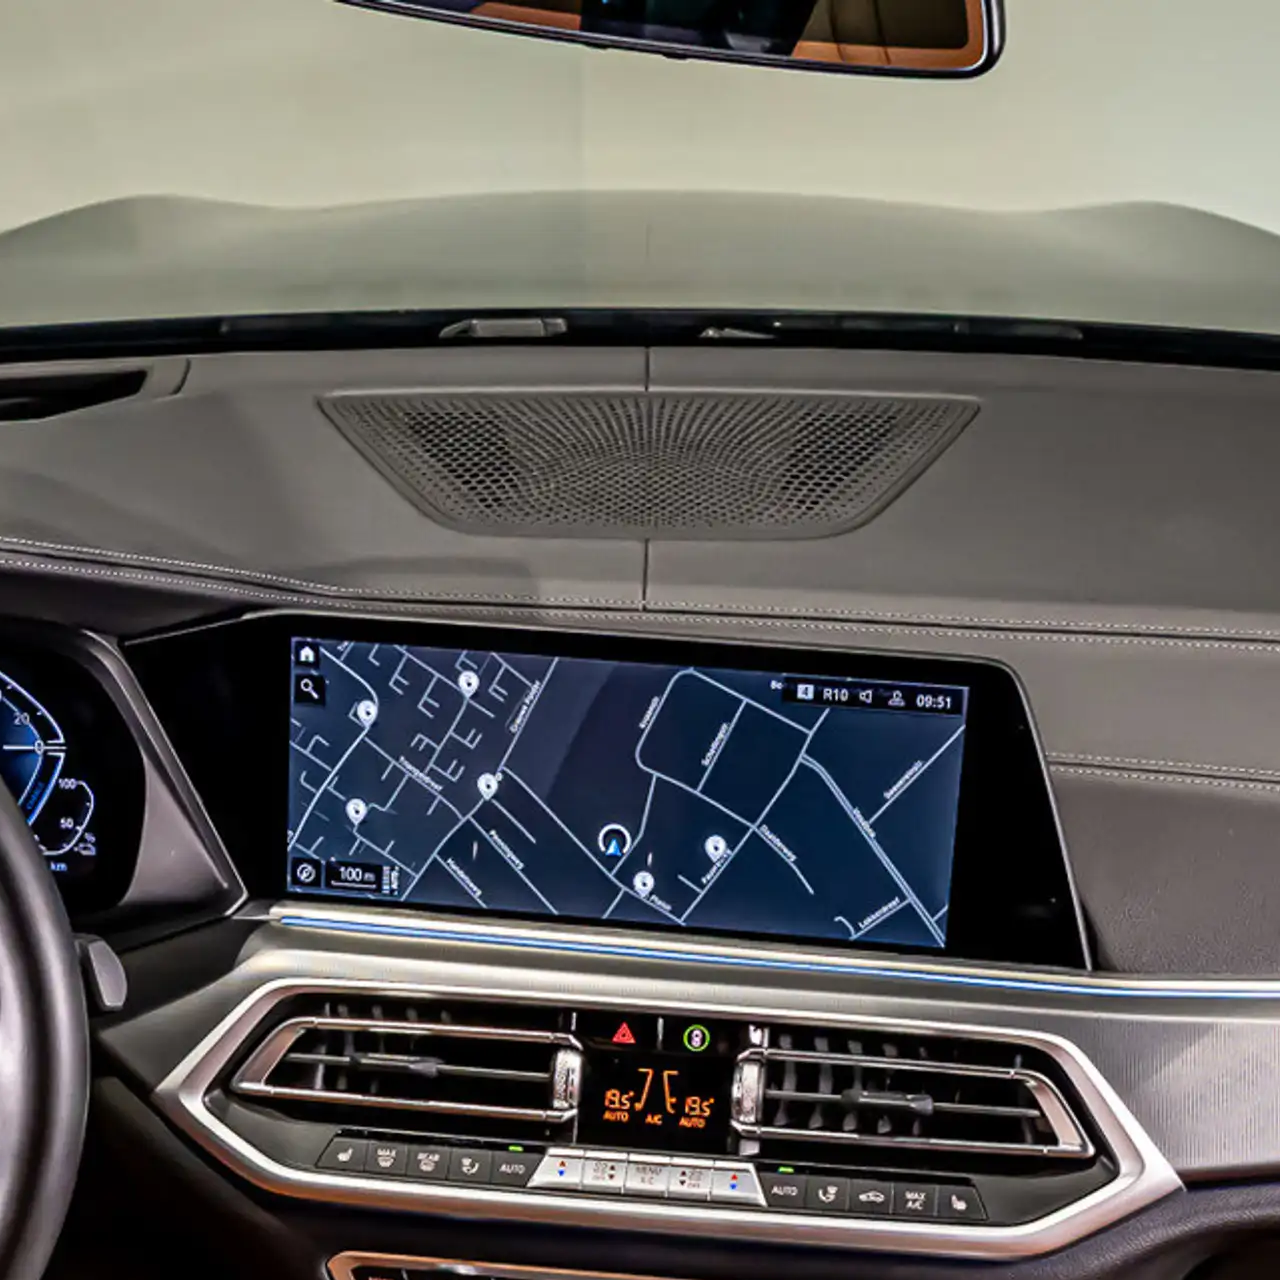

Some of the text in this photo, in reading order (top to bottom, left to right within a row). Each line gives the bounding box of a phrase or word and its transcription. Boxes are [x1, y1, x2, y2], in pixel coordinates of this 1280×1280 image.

[916, 694, 952, 709] 09:51
[13, 712, 30, 725] 20
[58, 778, 77, 790] 100
[60, 817, 74, 829] 50
[340, 867, 362, 882] 100
[603, 1111, 629, 1122] AUTO
[679, 1116, 706, 1128] AUTO
[377, 1148, 397, 1158] MAX
[499, 1164, 526, 1174] AUTO
[772, 1185, 798, 1197] AUTO
